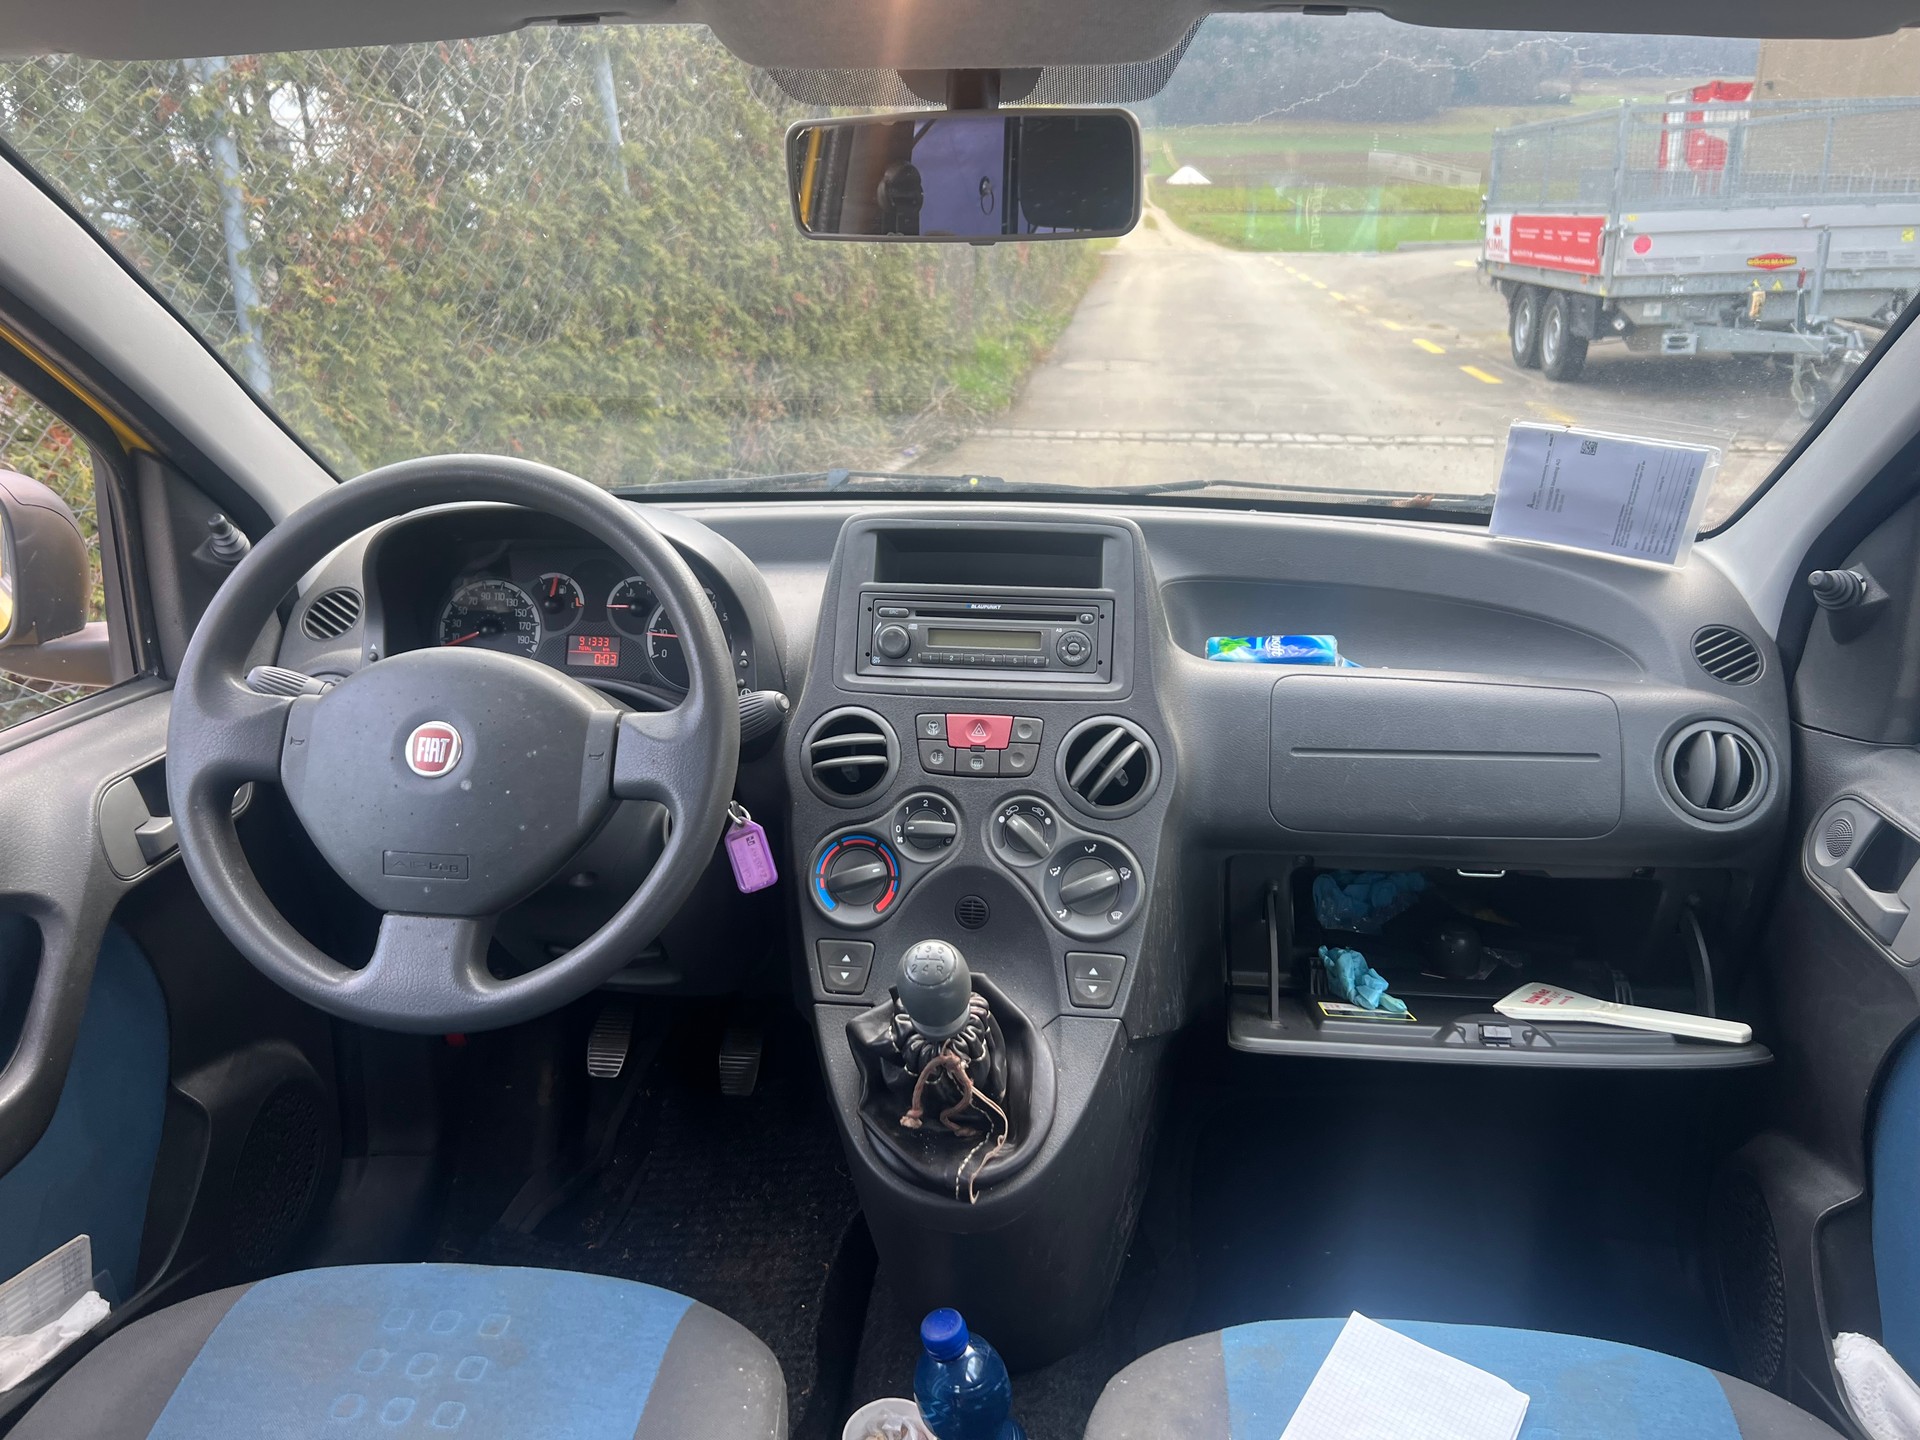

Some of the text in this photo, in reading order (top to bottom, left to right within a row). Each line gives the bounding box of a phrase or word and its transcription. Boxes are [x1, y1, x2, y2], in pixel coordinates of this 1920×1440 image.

[481, 592, 490, 600] 90
[494, 592, 505, 600] 110
[469, 597, 478, 605] 70
[506, 598, 518, 607] 130
[458, 607, 467, 615] 50
[515, 608, 527, 617] 150
[519, 621, 531, 630] 170
[517, 635, 529, 644] 190
[579, 636, 609, 647] 91333
[661, 649, 667, 658] 0
[594, 653, 616, 666] 0:03
[416, 737, 450, 763] FIAT
[905, 806, 909, 814] 1
[895, 825, 901, 833] 0
